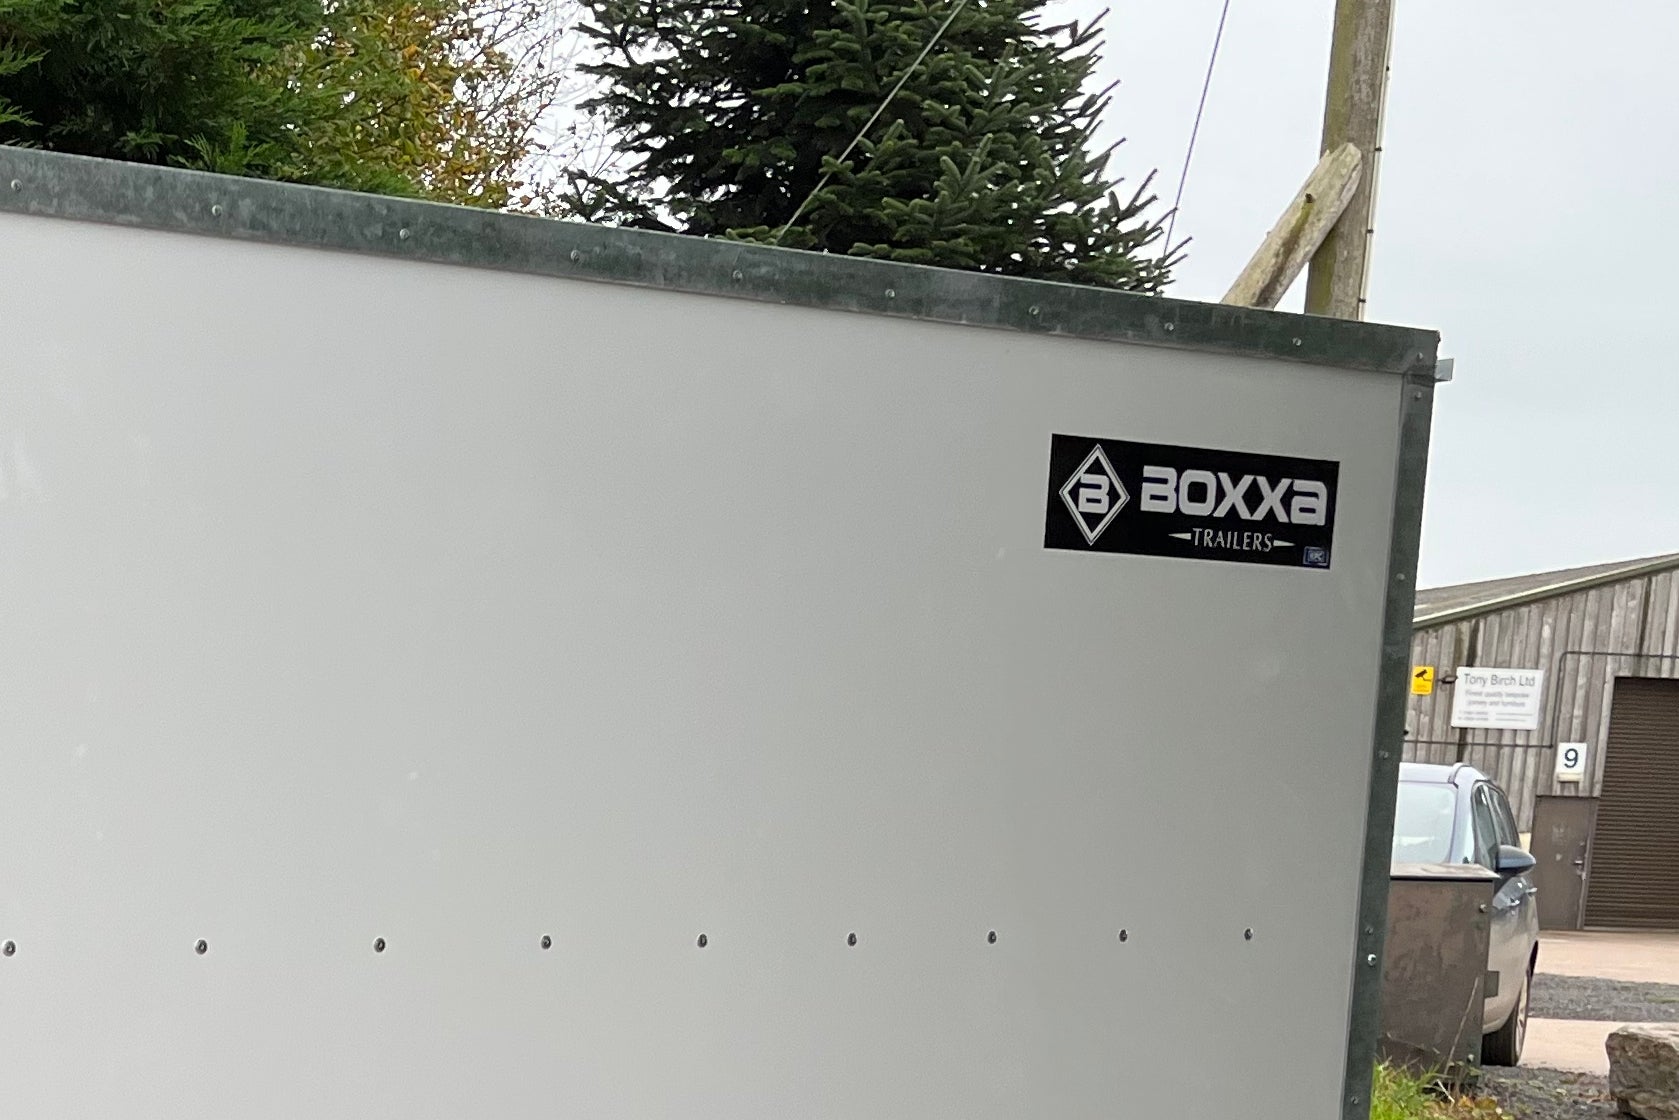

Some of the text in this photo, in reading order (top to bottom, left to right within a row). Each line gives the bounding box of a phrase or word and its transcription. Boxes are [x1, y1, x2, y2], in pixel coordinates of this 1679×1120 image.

[1191, 527, 1273, 552] TRAILERS
[1463, 672, 1536, 687] Tony Birch Ltd
[1564, 747, 1579, 769] 9
